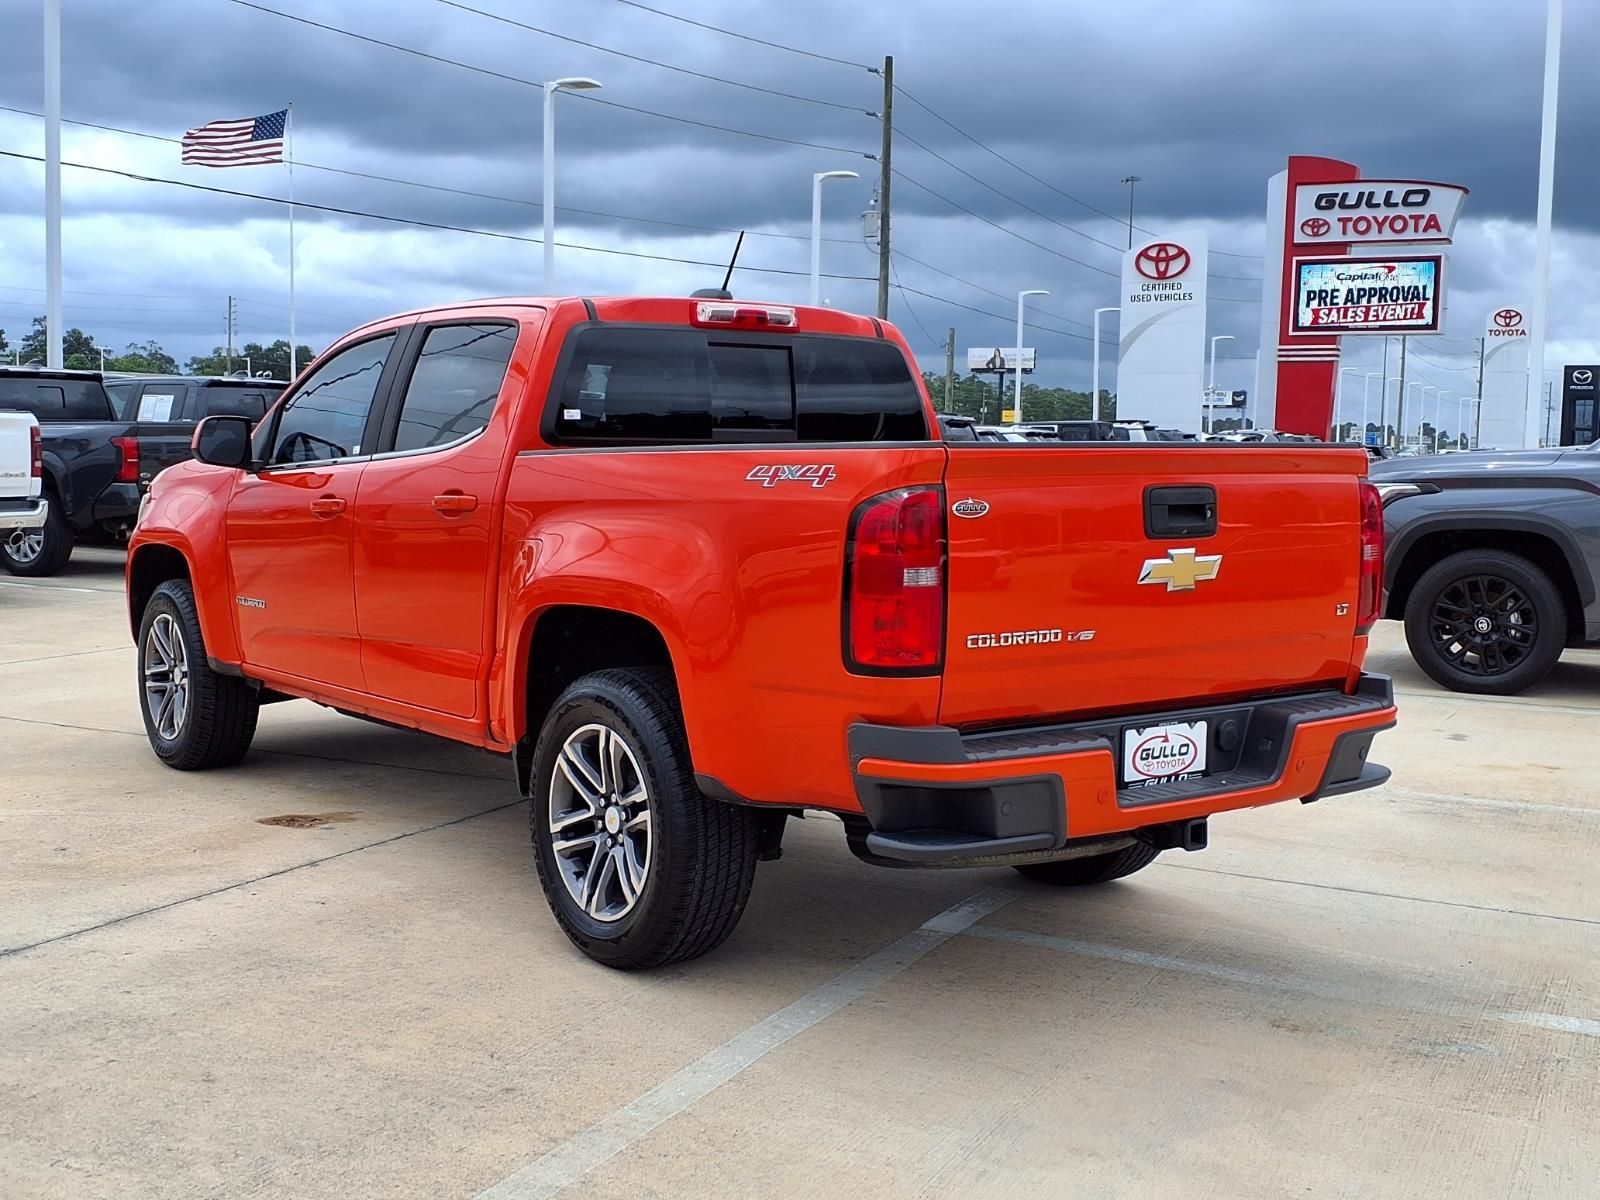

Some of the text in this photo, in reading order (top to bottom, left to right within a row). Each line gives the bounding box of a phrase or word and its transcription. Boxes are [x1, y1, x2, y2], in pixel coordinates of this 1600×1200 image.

[1314, 188, 1431, 211] GULLO
[1337, 214, 1442, 236] TOYOTA
[1336, 272, 1379, 283] Capital
[1141, 282, 1182, 292] CERTIFIED
[1130, 292, 1193, 303] USED VEHICLES
[1305, 285, 1430, 308] PRE APPROVAL
[1318, 303, 1419, 324] SALES EVENT!
[1488, 329, 1527, 337] TOYOTA
[745, 464, 837, 488] 4x4
[955, 503, 987, 512] GULLO
[966, 629, 1096, 649] COLORADO V6
[1140, 743, 1190, 761] GULLO
[1155, 757, 1187, 769] TOYOTA
